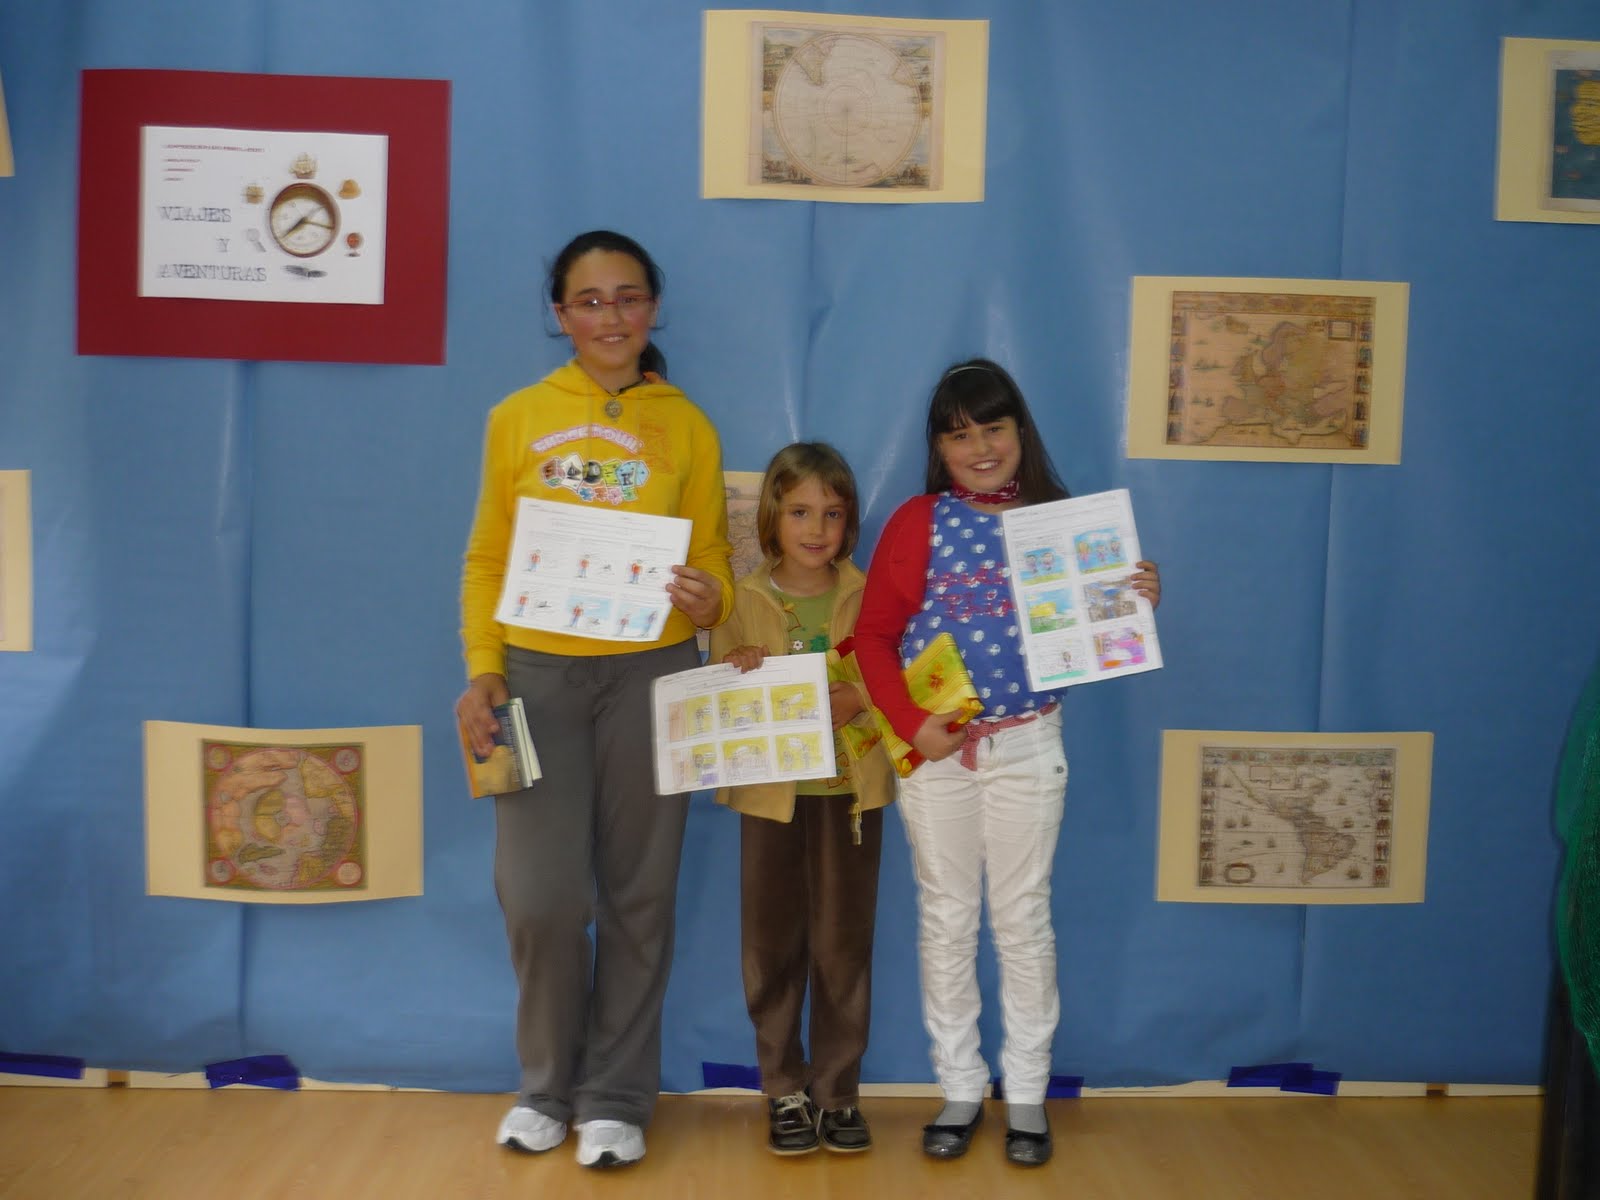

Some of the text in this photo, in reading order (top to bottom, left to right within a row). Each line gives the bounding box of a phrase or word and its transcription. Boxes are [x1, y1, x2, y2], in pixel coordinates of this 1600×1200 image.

[159, 206, 231, 222] VIAJES
[216, 239, 231, 253] Y
[158, 264, 267, 281] AVENTURAS
